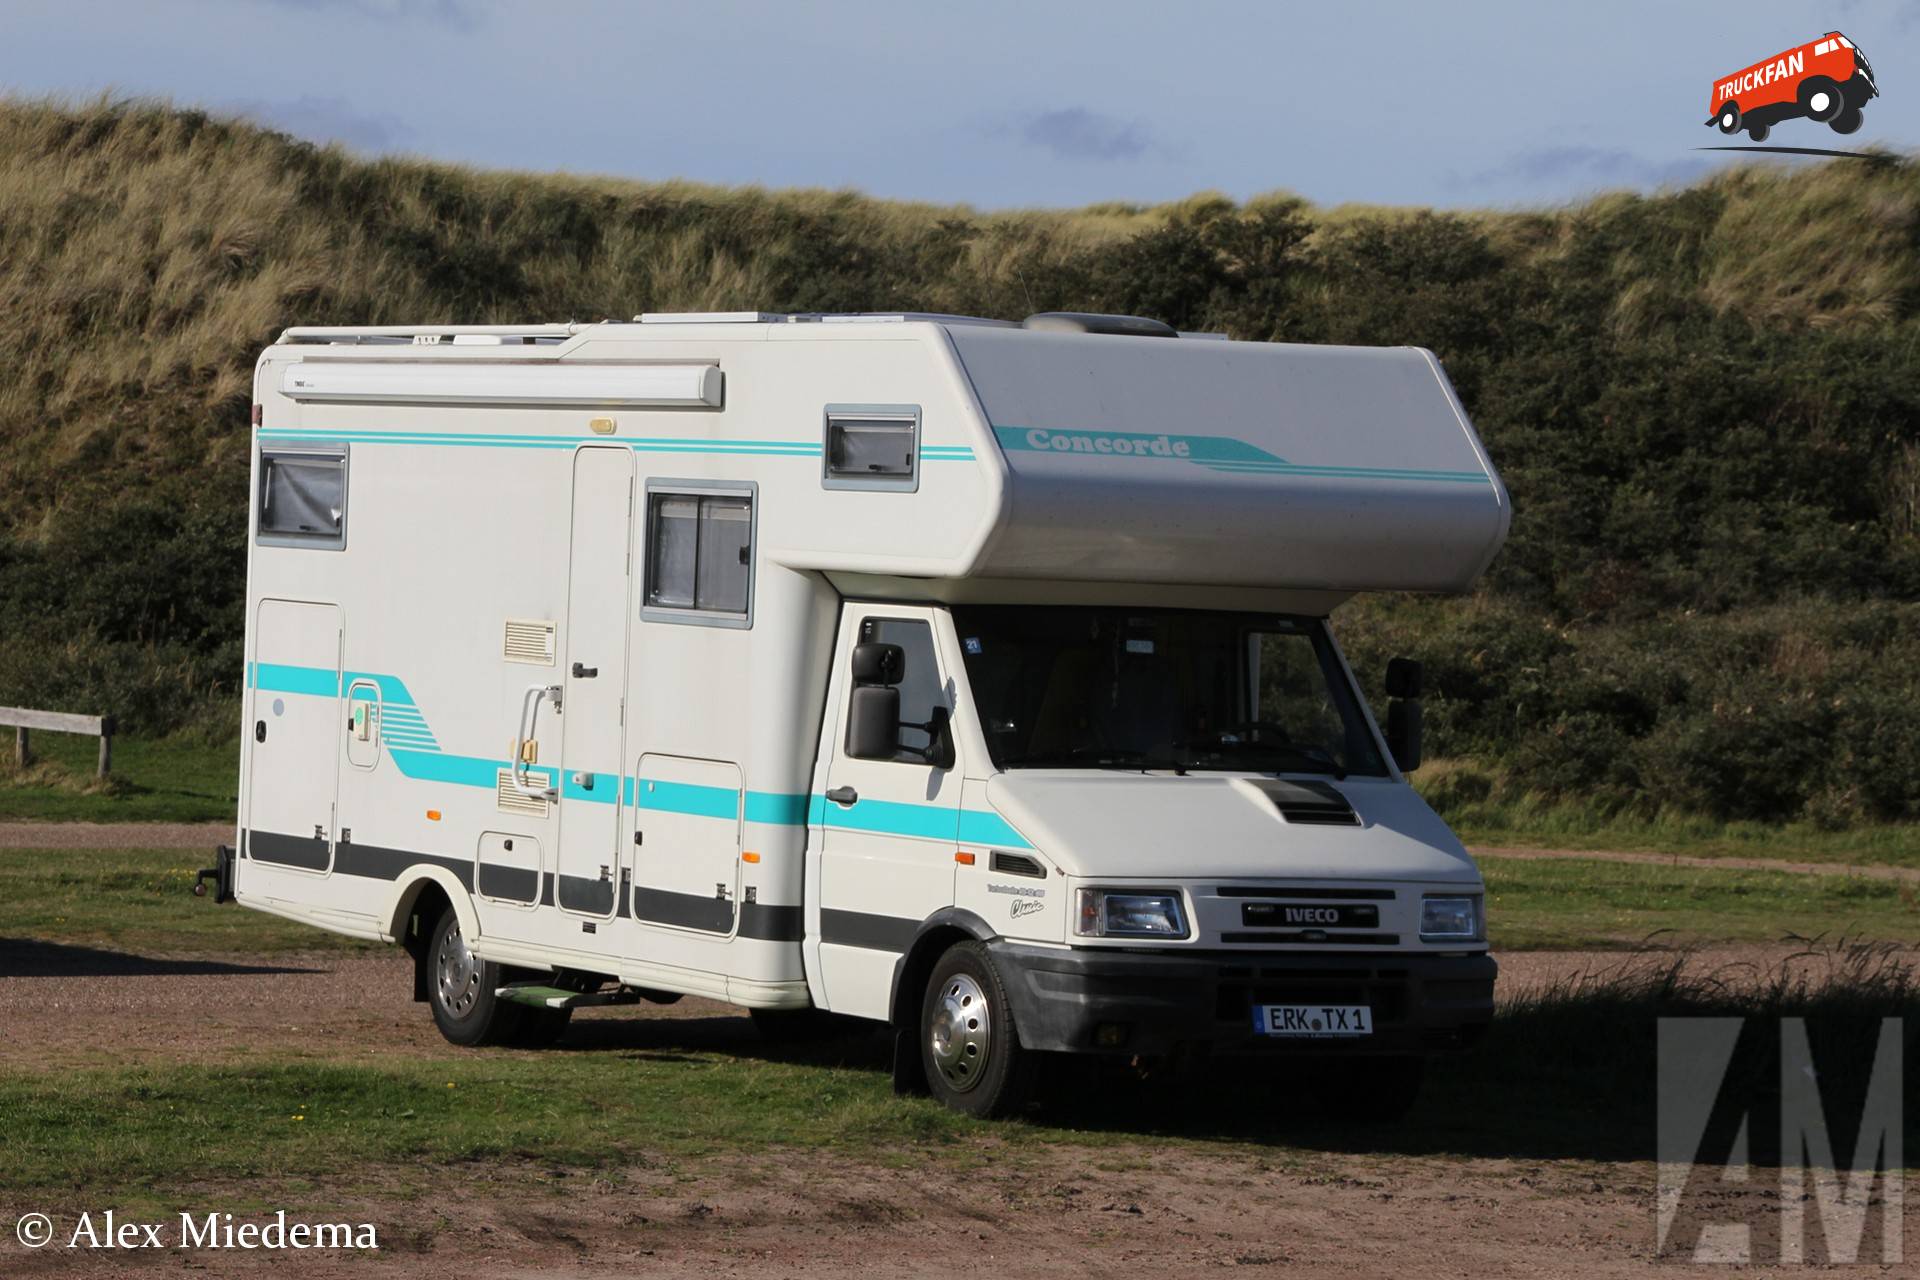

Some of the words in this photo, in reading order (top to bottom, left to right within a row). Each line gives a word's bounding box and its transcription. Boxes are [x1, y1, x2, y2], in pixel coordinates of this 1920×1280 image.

[1026, 429, 1190, 457] Concorde
[966, 639, 978, 650] 21
[1285, 907, 1339, 923] IVECO
[1269, 1007, 1310, 1030] ERK
